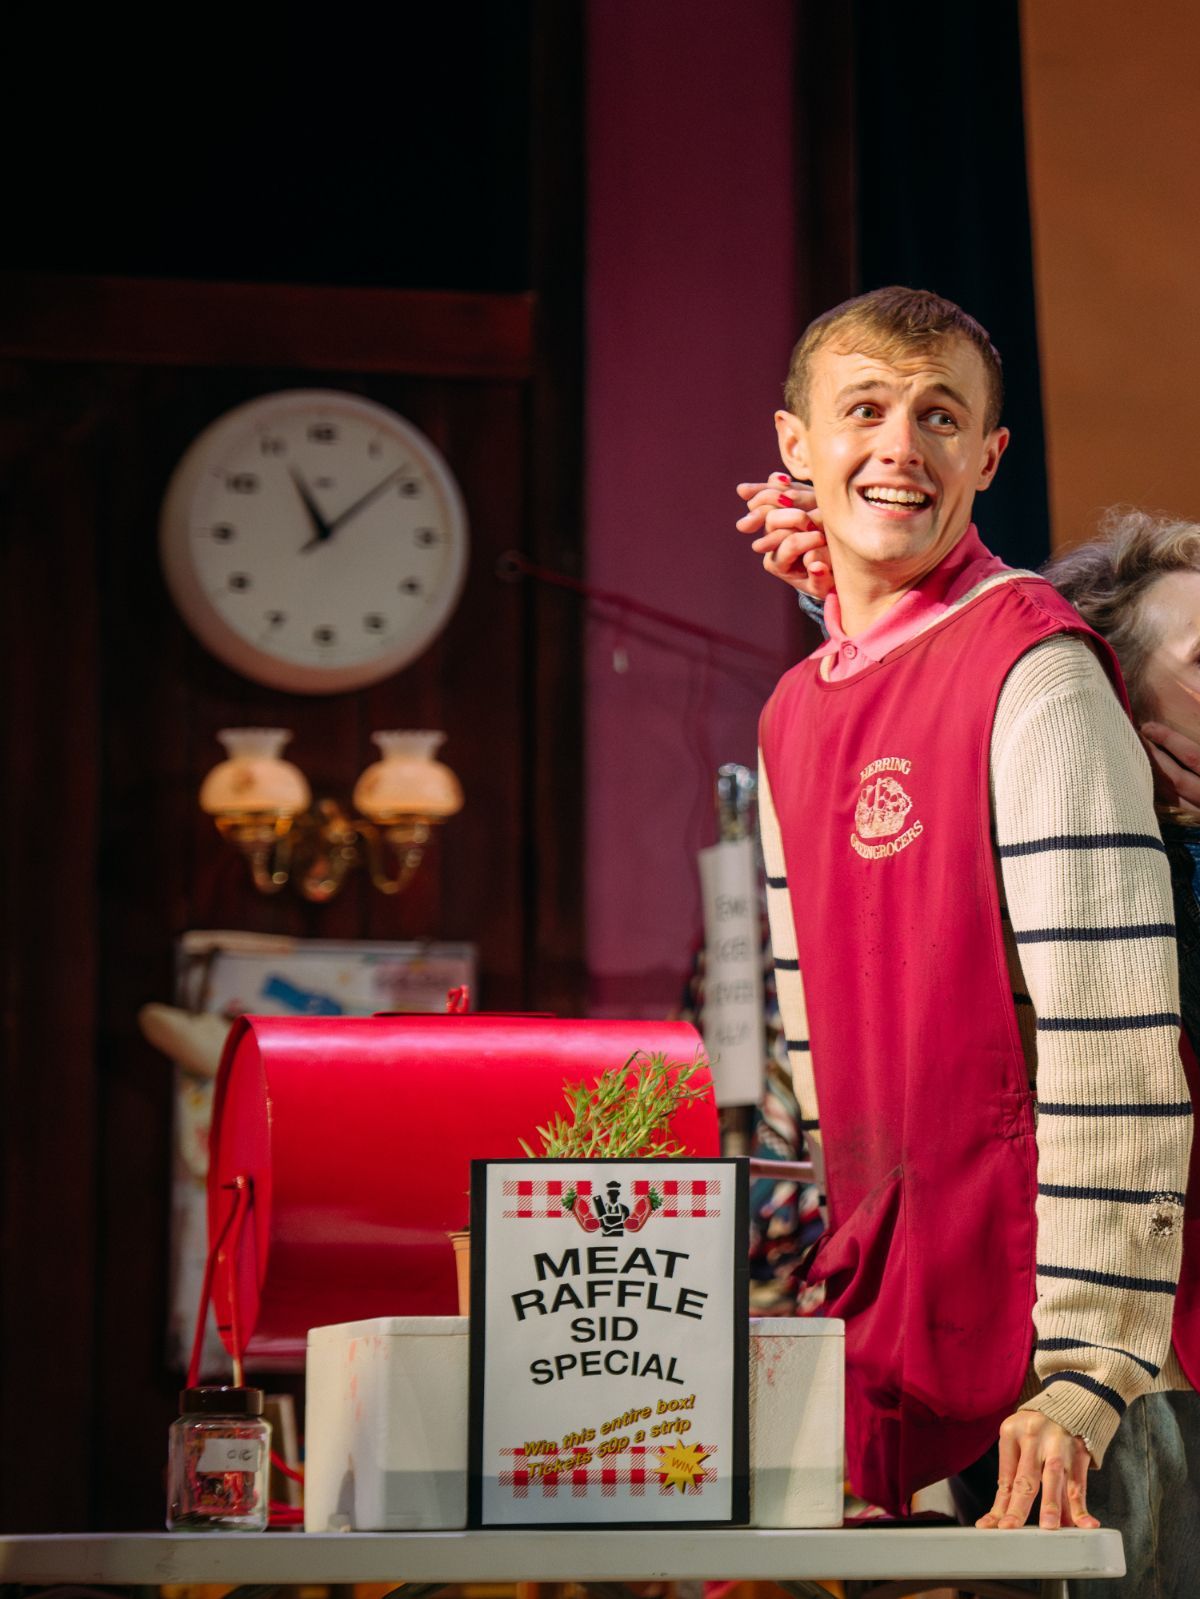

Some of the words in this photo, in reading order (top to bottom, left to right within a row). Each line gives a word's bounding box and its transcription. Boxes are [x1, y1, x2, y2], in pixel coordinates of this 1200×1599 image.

[860, 757, 912, 784] HERRING
[533, 1246, 690, 1281] MEAT
[511, 1280, 708, 1321] RAFFLE
[570, 1316, 638, 1343] SID
[529, 1350, 685, 1385] SPECIAL
[523, 1441, 558, 1457] Win
[562, 1428, 596, 1450] this
[600, 1406, 652, 1436] entire
[655, 1394, 696, 1415] box!
[527, 1452, 593, 1478] Tickets
[597, 1436, 630, 1458] 50p
[634, 1429, 646, 1443] a
[650, 1417, 691, 1438] strip
[671, 1457, 694, 1474] WIN
